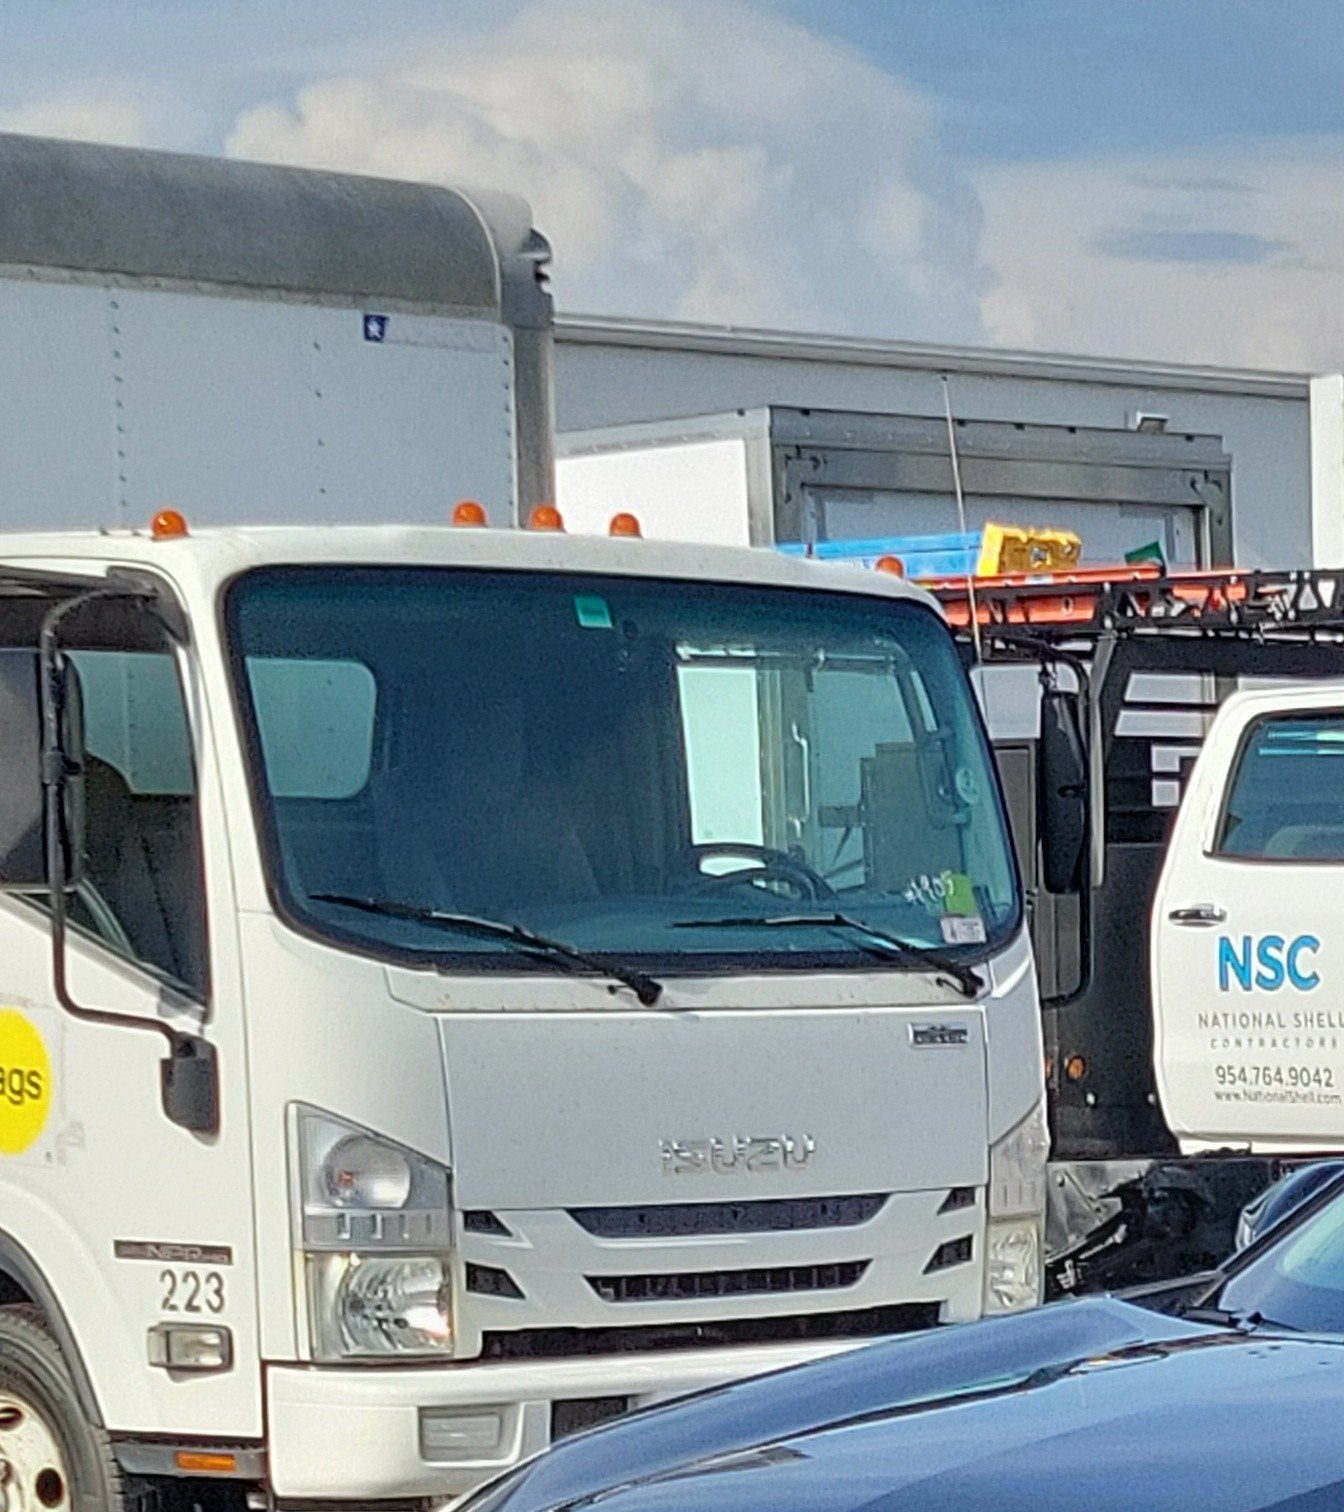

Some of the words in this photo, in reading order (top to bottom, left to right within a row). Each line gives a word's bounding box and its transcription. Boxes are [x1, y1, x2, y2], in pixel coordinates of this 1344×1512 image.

[1218, 934, 1321, 992] NSC
[1198, 1010, 1287, 1030] NATIONAL
[1210, 1036, 1338, 1050] CONTRACTORS
[1215, 1064, 1335, 1088] 954.764.9042
[658, 1133, 817, 1177] ISUZU
[159, 1269, 225, 1314] 223
